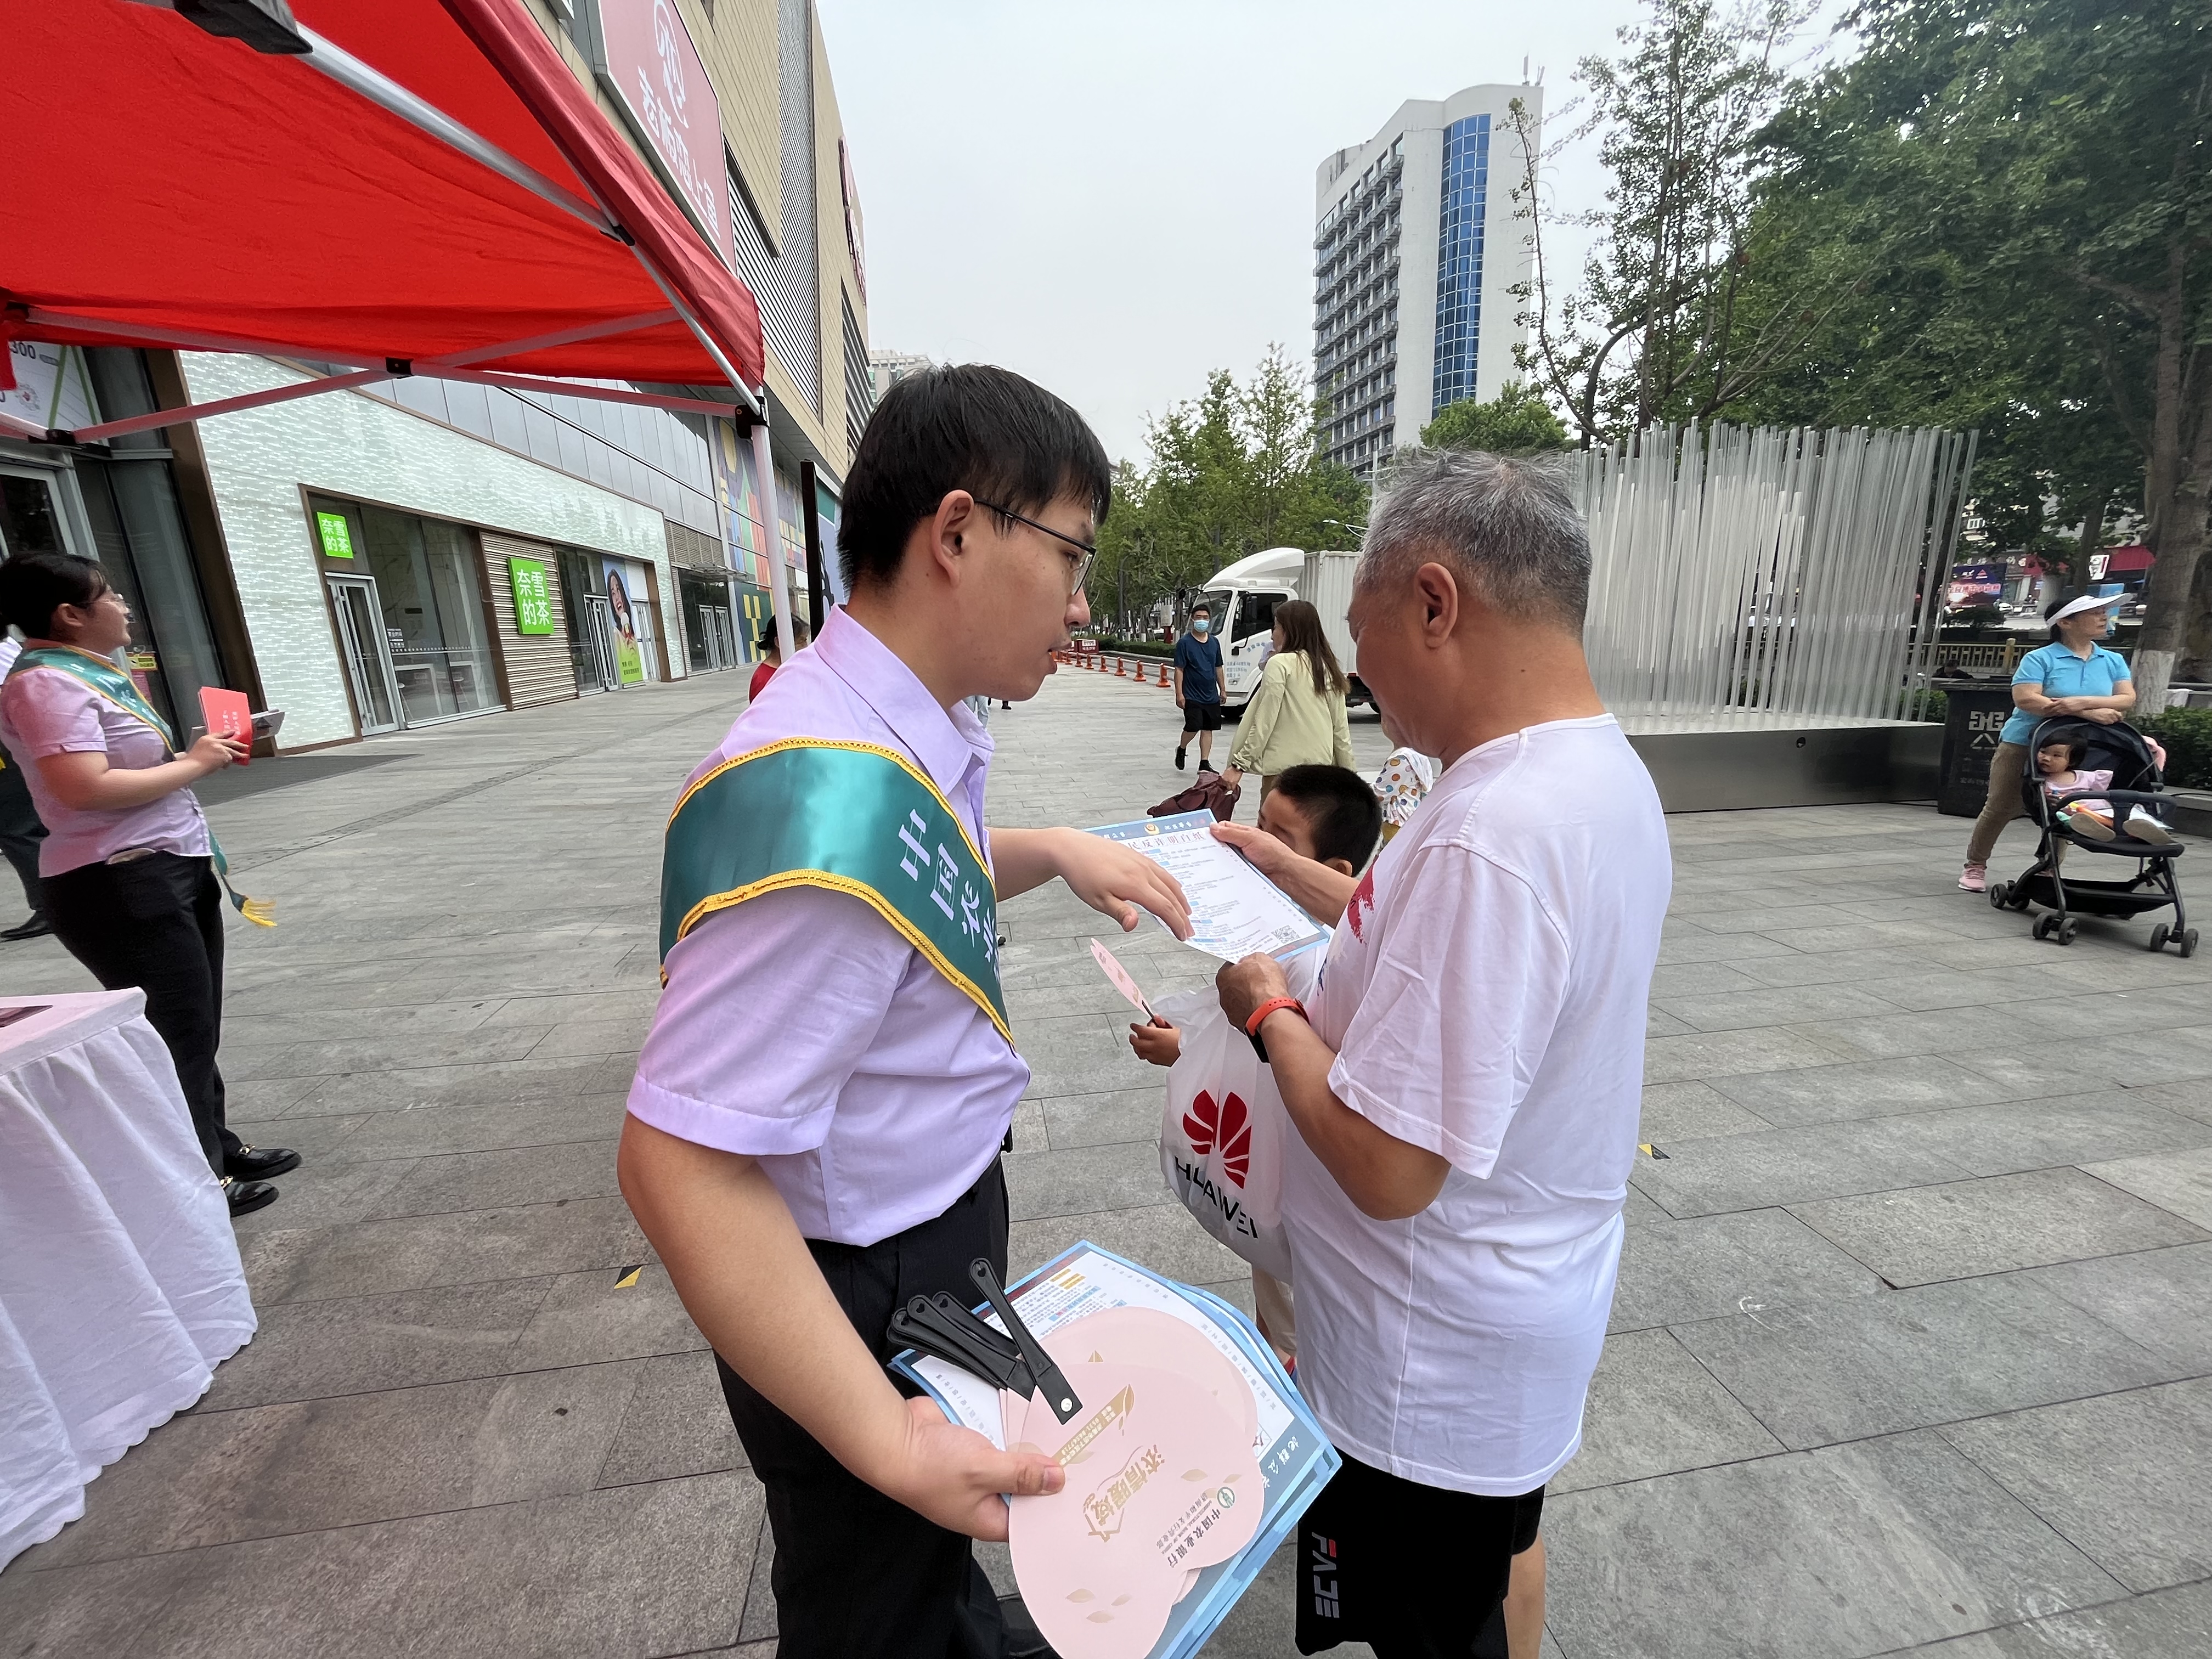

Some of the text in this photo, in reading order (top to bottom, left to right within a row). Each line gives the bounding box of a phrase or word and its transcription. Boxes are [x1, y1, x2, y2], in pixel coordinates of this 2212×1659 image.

[321, 518, 346, 538] 奈雪
[325, 535, 350, 554] 的茶
[516, 568, 545, 598] 奈雪
[522, 598, 550, 626] 的茶
[898, 808, 1002, 984] 中国农业
[1175, 1155, 1259, 1239] HUAWEI
[1167, 1509, 1221, 1568] 中国农业银行
